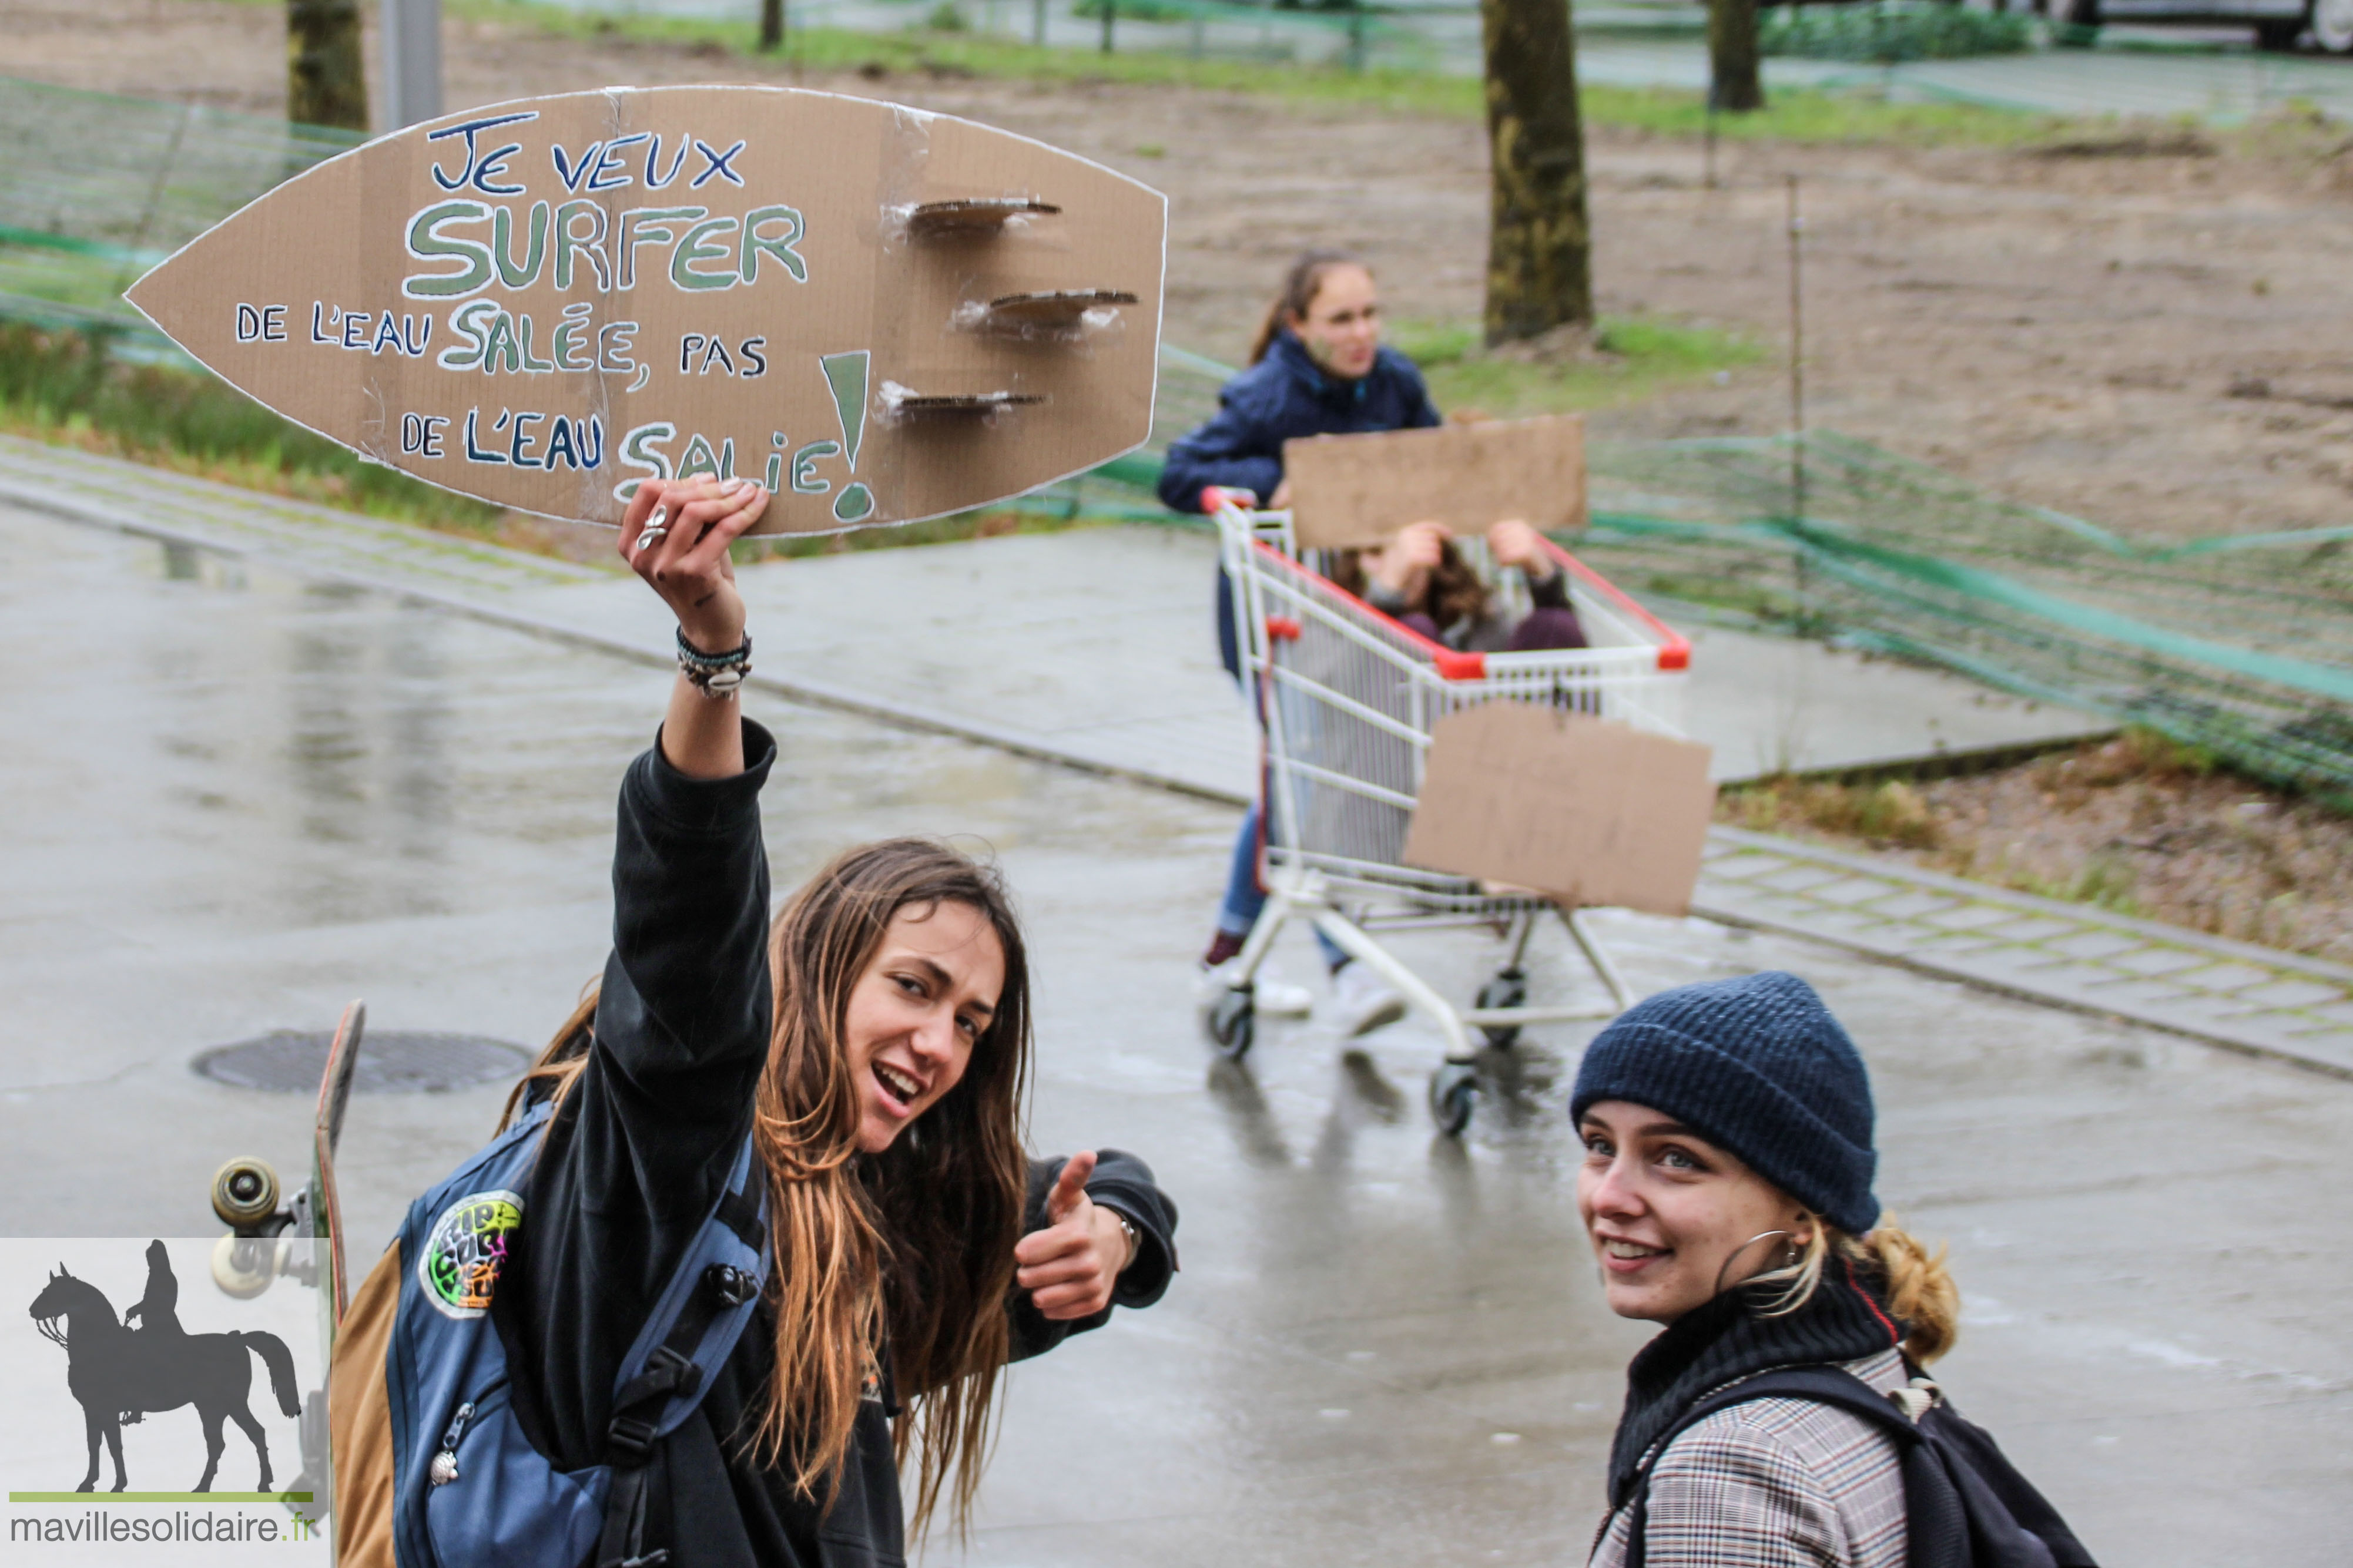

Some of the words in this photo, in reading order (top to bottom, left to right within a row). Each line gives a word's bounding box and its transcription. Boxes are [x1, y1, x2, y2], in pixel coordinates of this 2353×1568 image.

[551, 130, 746, 194] VEUX
[402, 199, 807, 300] SURFER
[236, 302, 288, 342] DE
[311, 300, 433, 356] L'EAU
[680, 332, 767, 378] PAS
[402, 412, 450, 456] DE
[465, 405, 604, 472] L'EAU
